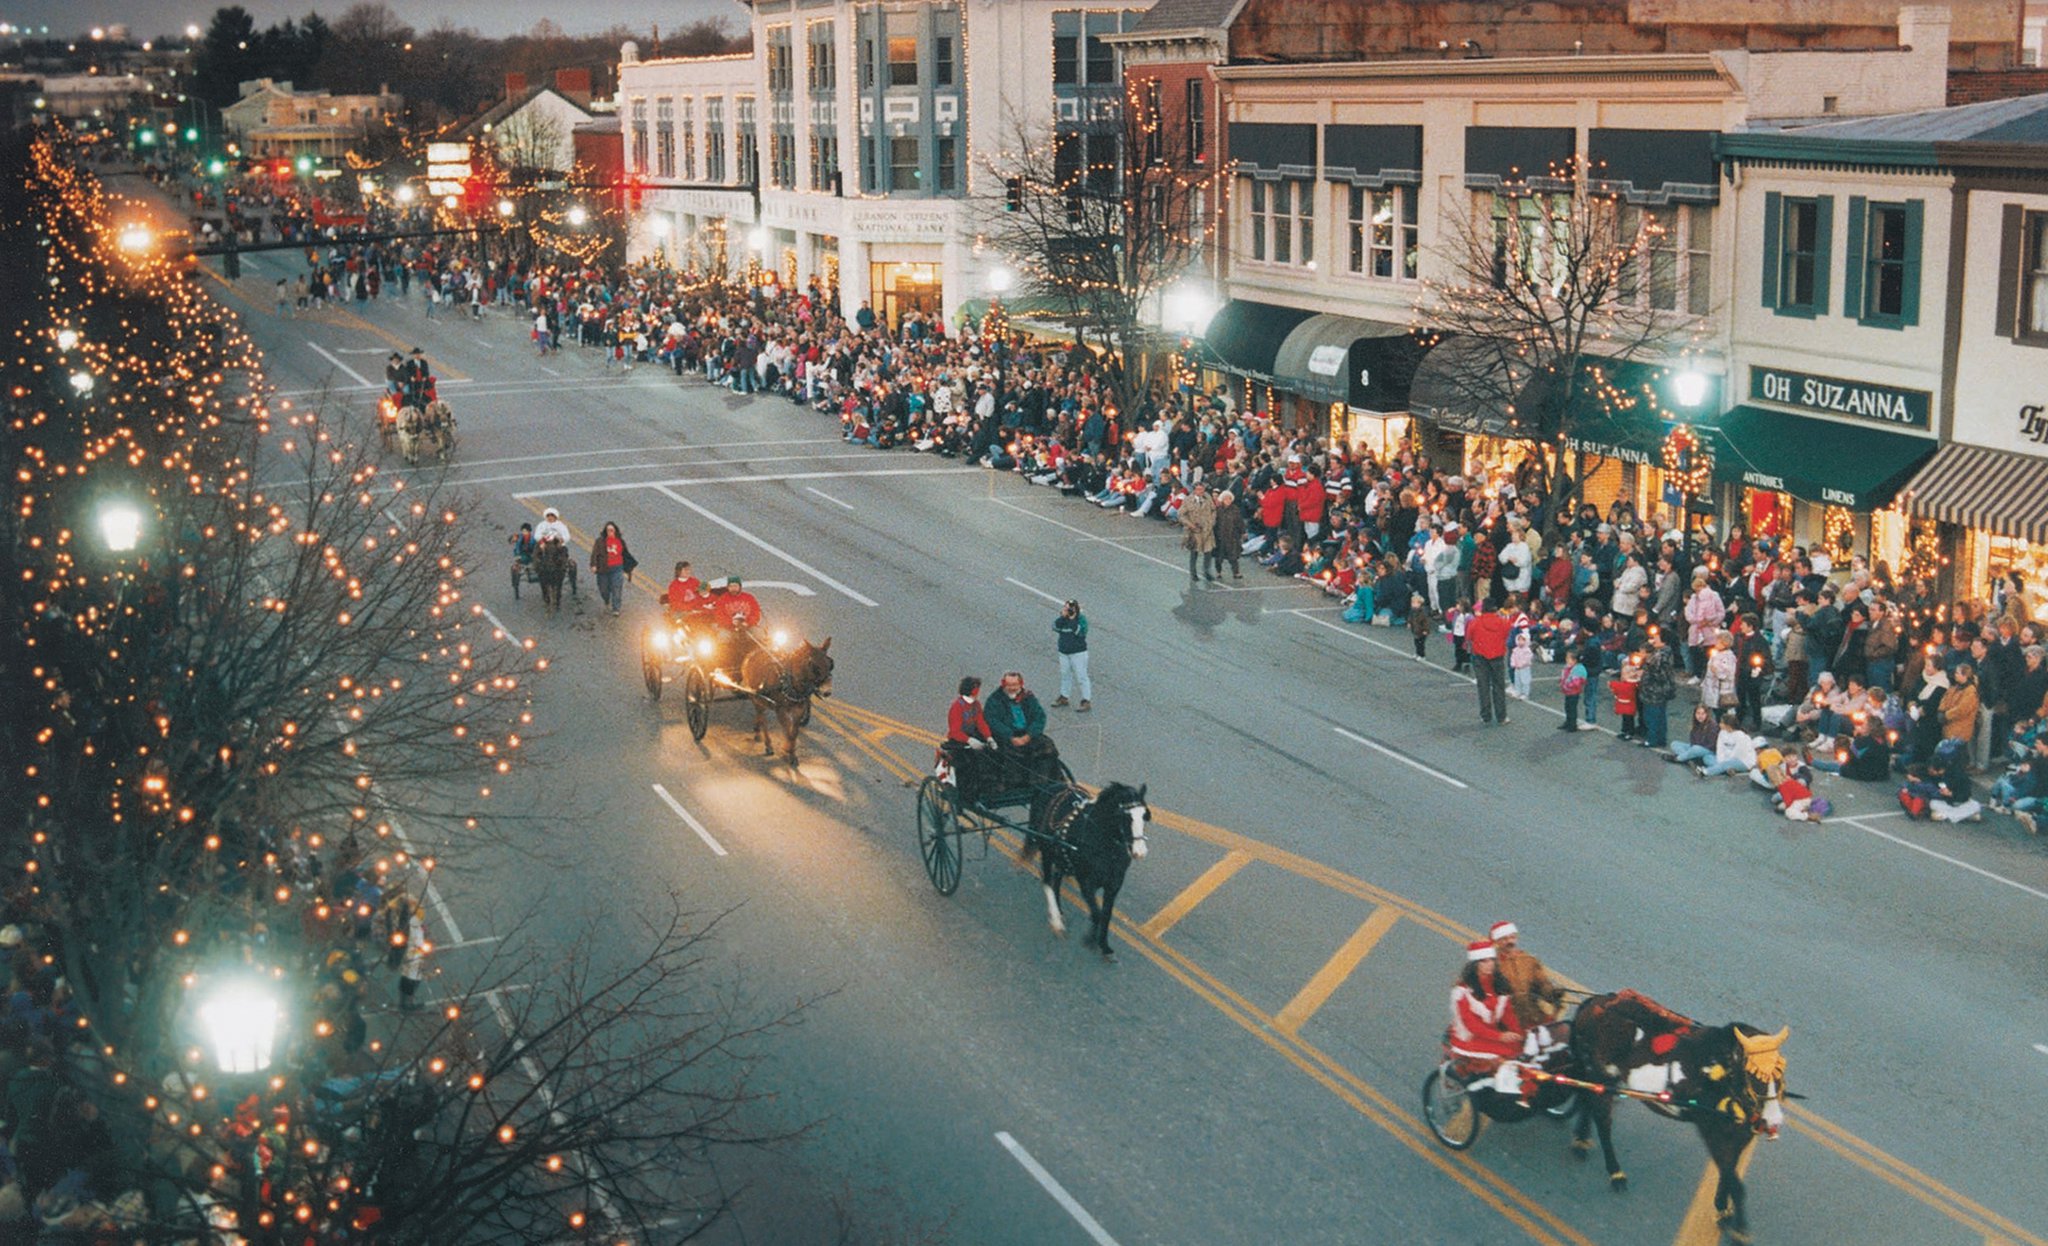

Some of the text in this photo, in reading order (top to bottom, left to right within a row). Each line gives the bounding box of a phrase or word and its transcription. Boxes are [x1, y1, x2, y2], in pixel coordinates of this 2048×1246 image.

[856, 223, 946, 234] NATIONAL BANK
[1763, 372, 1914, 423] OH SUZANNA
[1743, 470, 1784, 489] ANTIQUES
[1822, 487, 1856, 506] LINENS
